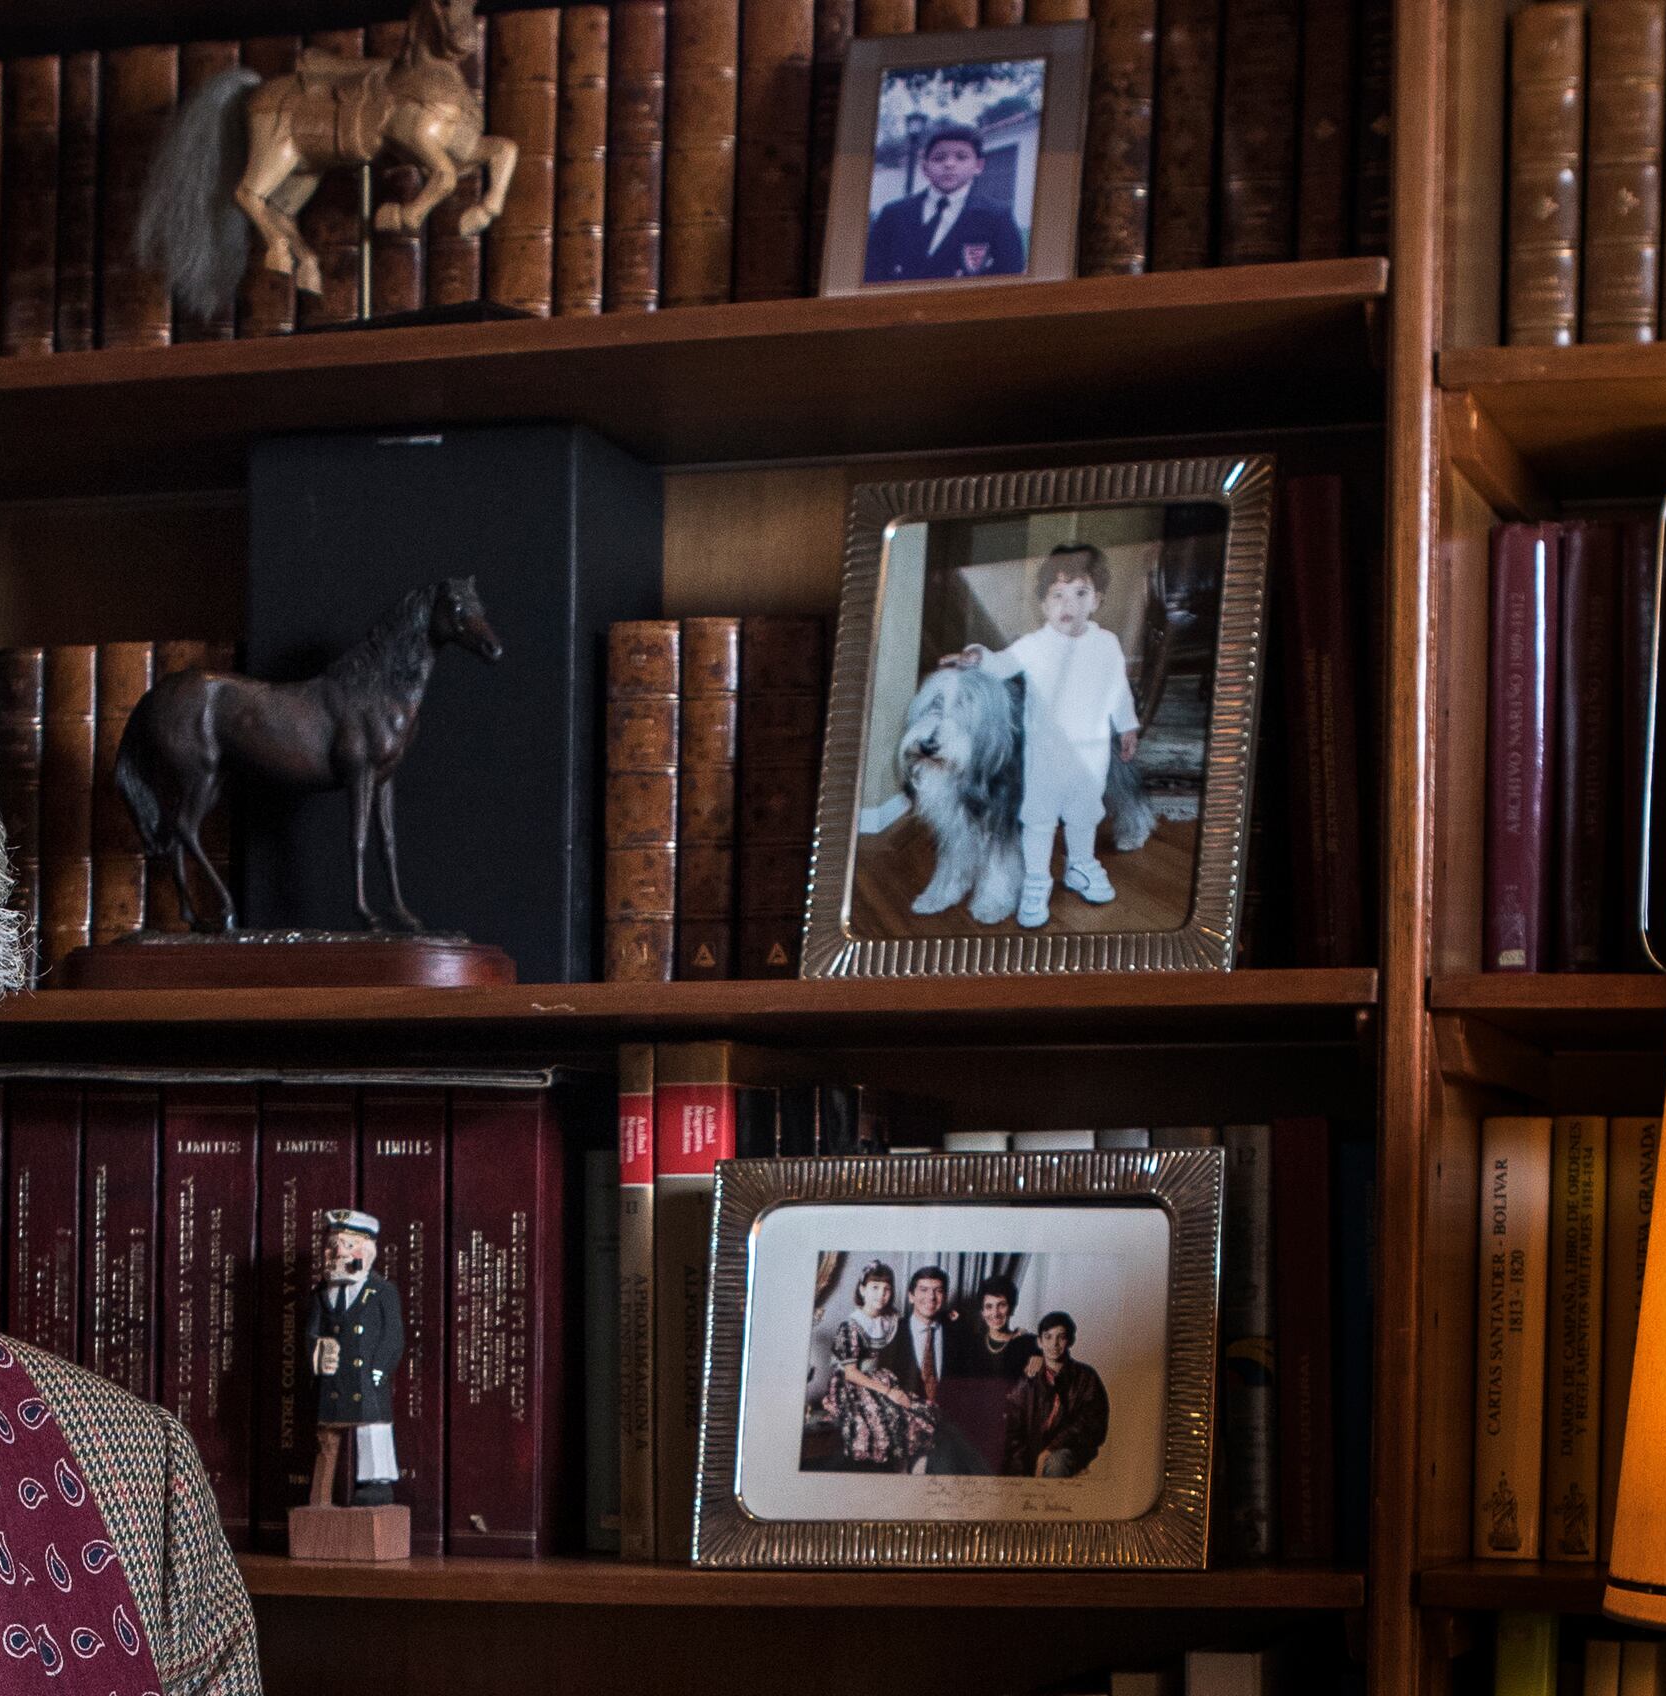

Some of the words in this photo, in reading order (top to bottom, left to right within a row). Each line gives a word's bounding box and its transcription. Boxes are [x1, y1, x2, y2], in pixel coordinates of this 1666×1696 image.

[1510, 592, 1526, 668] 1809-1812
[1505, 674, 1524, 748] NARIÑO
[1506, 750, 1523, 834] ARCHIVO
[178, 1140, 241, 1153] LIMITES
[1568, 1121, 1582, 1196] ORDENES
[1639, 1123, 1656, 1214] GRANADA
[179, 1175, 195, 1273] VENEZUELA
[283, 1178, 297, 1275] VENEZUELA
[1493, 1158, 1509, 1235] BOLIVAR
[1566, 1199, 1579, 1222] DE
[1509, 1249, 1525, 1284] 1820
[1565, 1227, 1578, 1274] LIBRO
[1579, 1213, 1593, 1298] MILITARES
[178, 1299, 194, 1384] COLOMBIA
[685, 1265, 700, 1360] ALFONSO
[1489, 1253, 1505, 1360] SANTANDER
[1508, 1300, 1523, 1335] 1813
[281, 1302, 296, 1388] COLOMBIA
[512, 1336, 525, 1358] DE
[1562, 1365, 1576, 1386] DE
[1576, 1303, 1590, 1421] REGLAMENTOS
[281, 1396, 295, 1449] ENTRE
[512, 1365, 526, 1421] ACTAS
[1487, 1366, 1504, 1436] CARTAS
[1560, 1390, 1575, 1456] DIARIOS
[1576, 1425, 1588, 1436] Y
